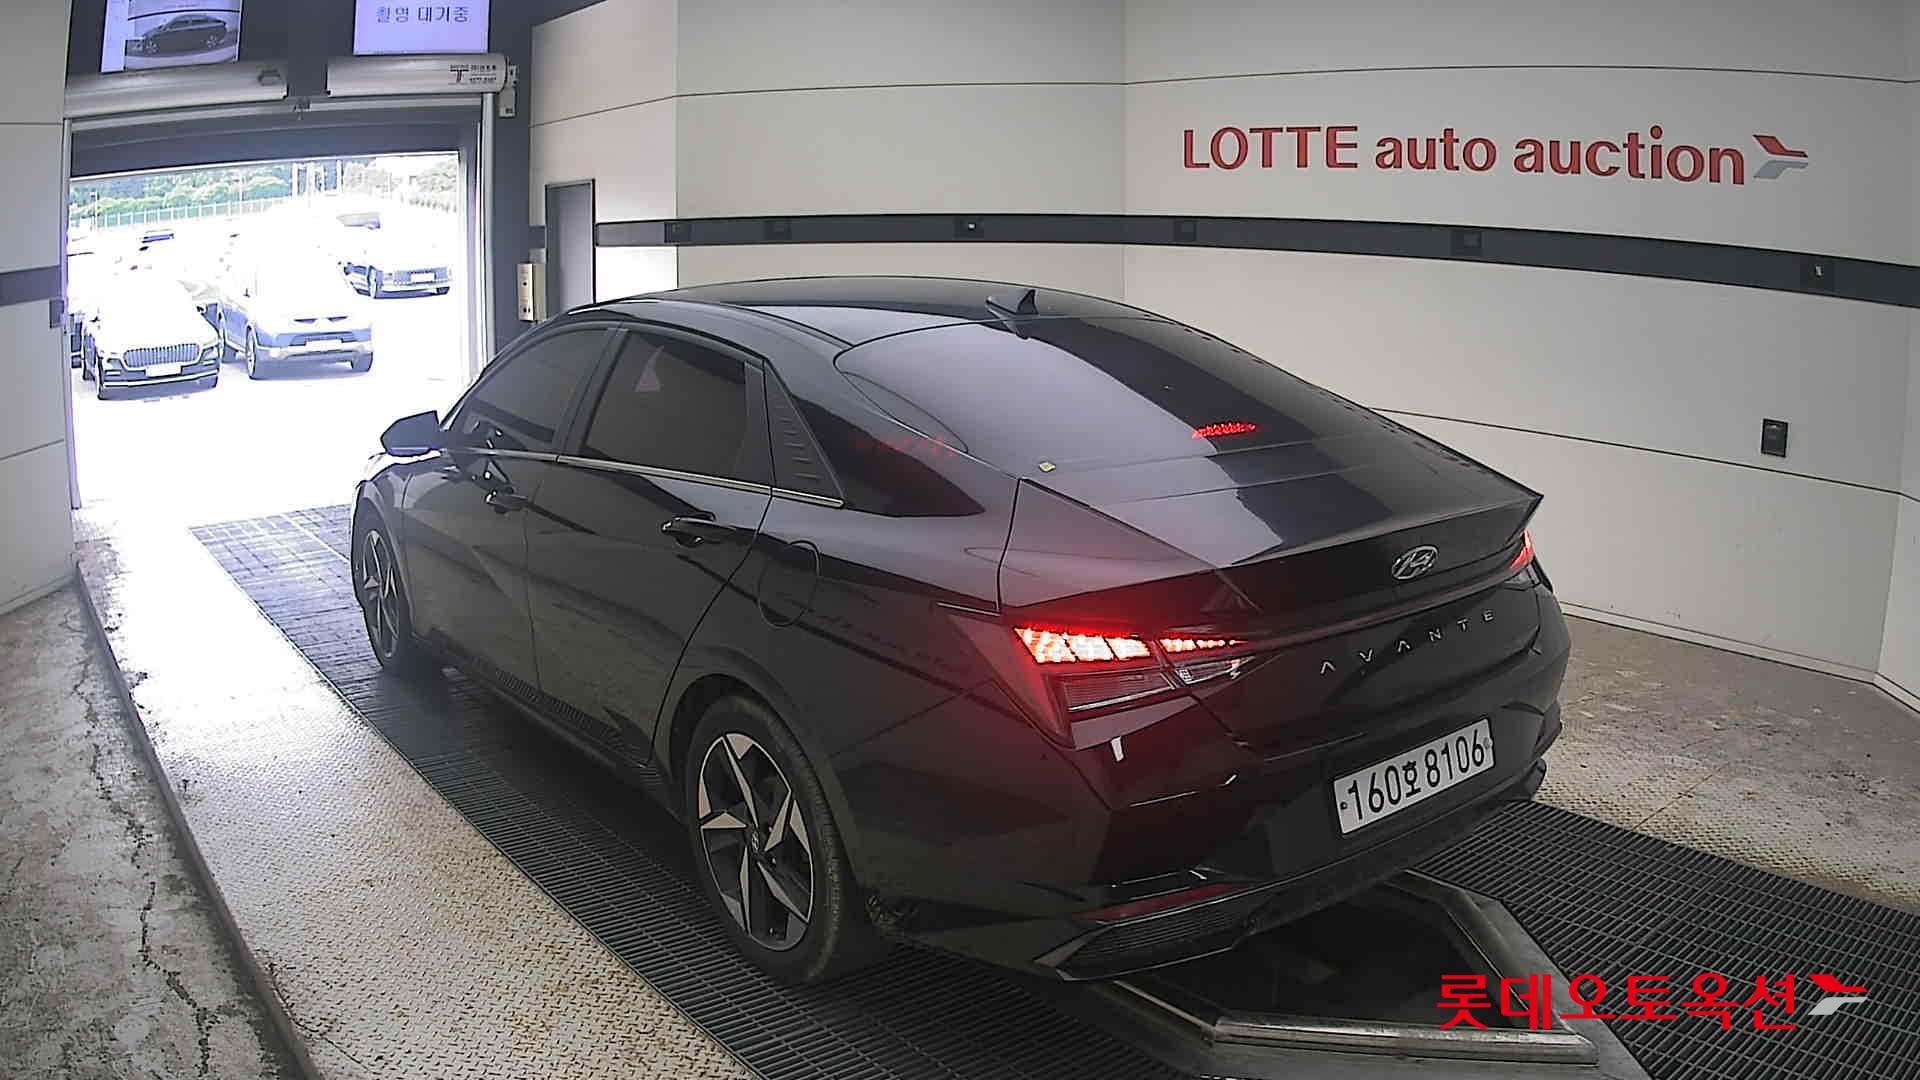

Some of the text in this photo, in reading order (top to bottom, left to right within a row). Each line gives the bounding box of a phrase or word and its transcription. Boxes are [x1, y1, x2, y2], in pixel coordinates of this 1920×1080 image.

[418, 6, 469, 23] 대기중
[1183, 125, 1745, 185] LOTTE auto auction
[1320, 610, 1496, 674] AVANTE
